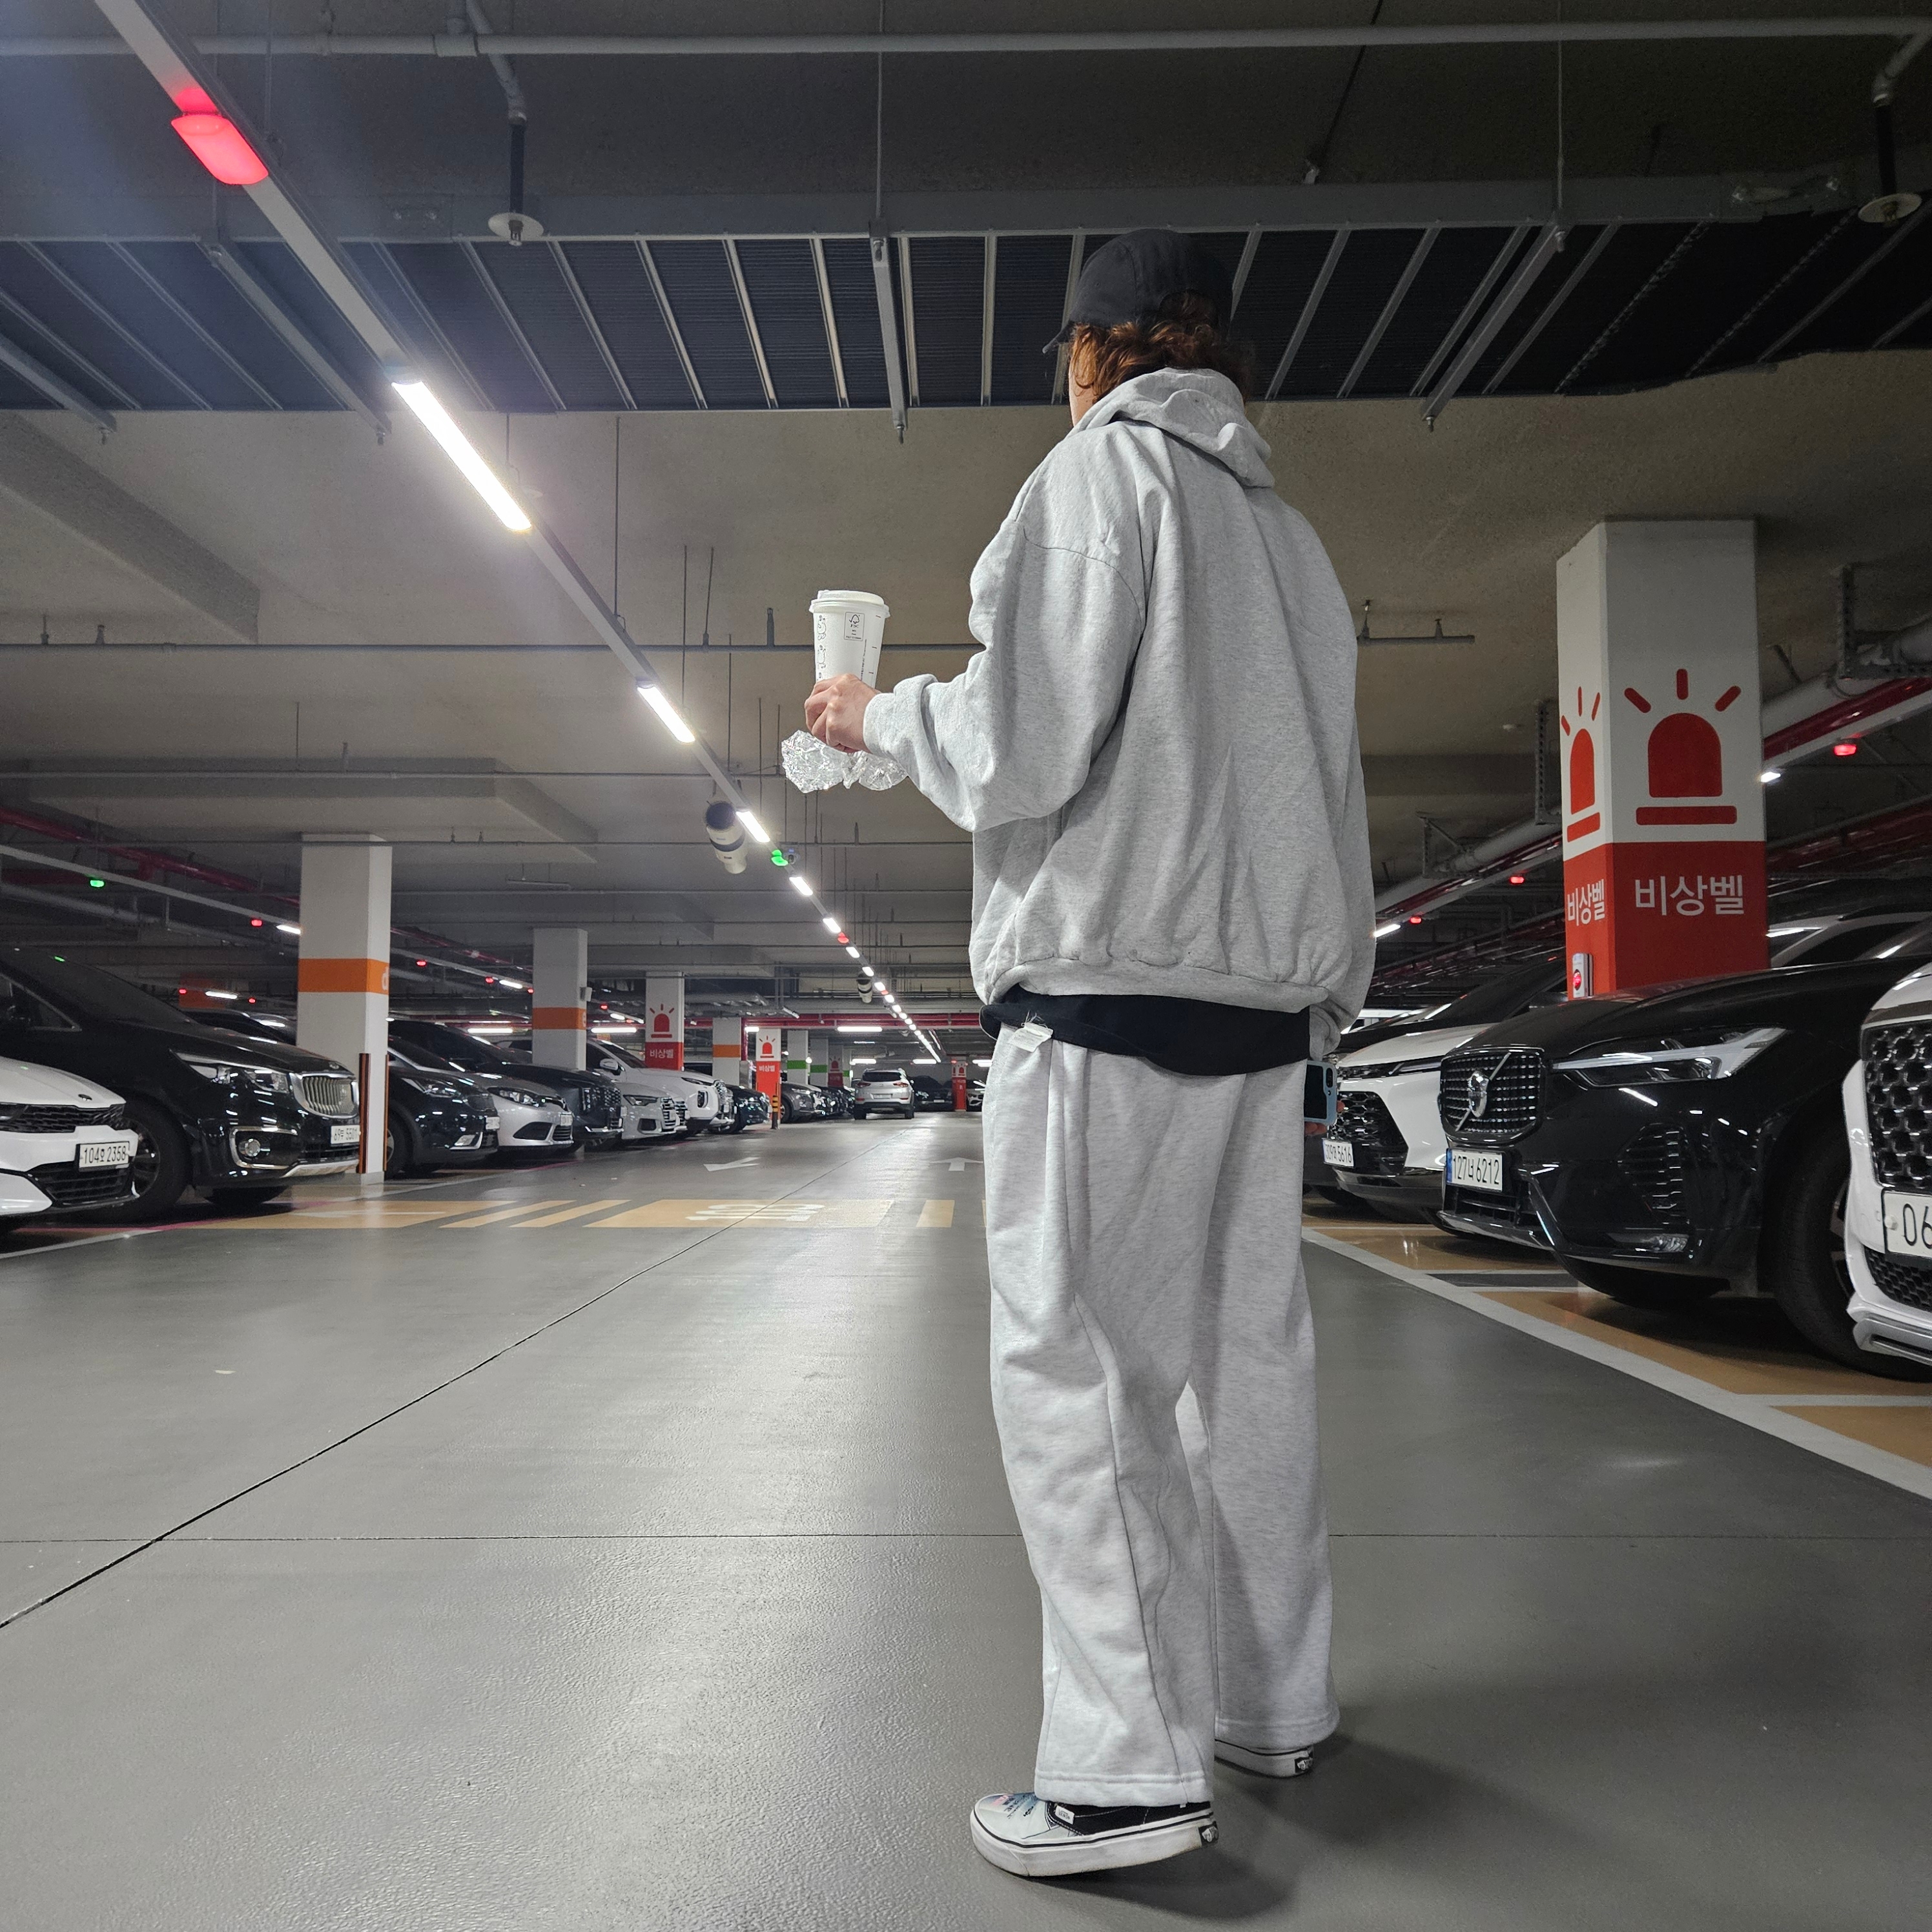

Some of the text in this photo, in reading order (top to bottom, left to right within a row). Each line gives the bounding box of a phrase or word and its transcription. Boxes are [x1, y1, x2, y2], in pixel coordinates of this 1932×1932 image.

[1567, 879, 1606, 926] 비상벨
[1635, 874, 1745, 916] 비상벨
[650, 1049, 674, 1059] 비상벨
[85, 1146, 126, 1164] 104오 2358
[1453, 1155, 1500, 1185] 127너 6212
